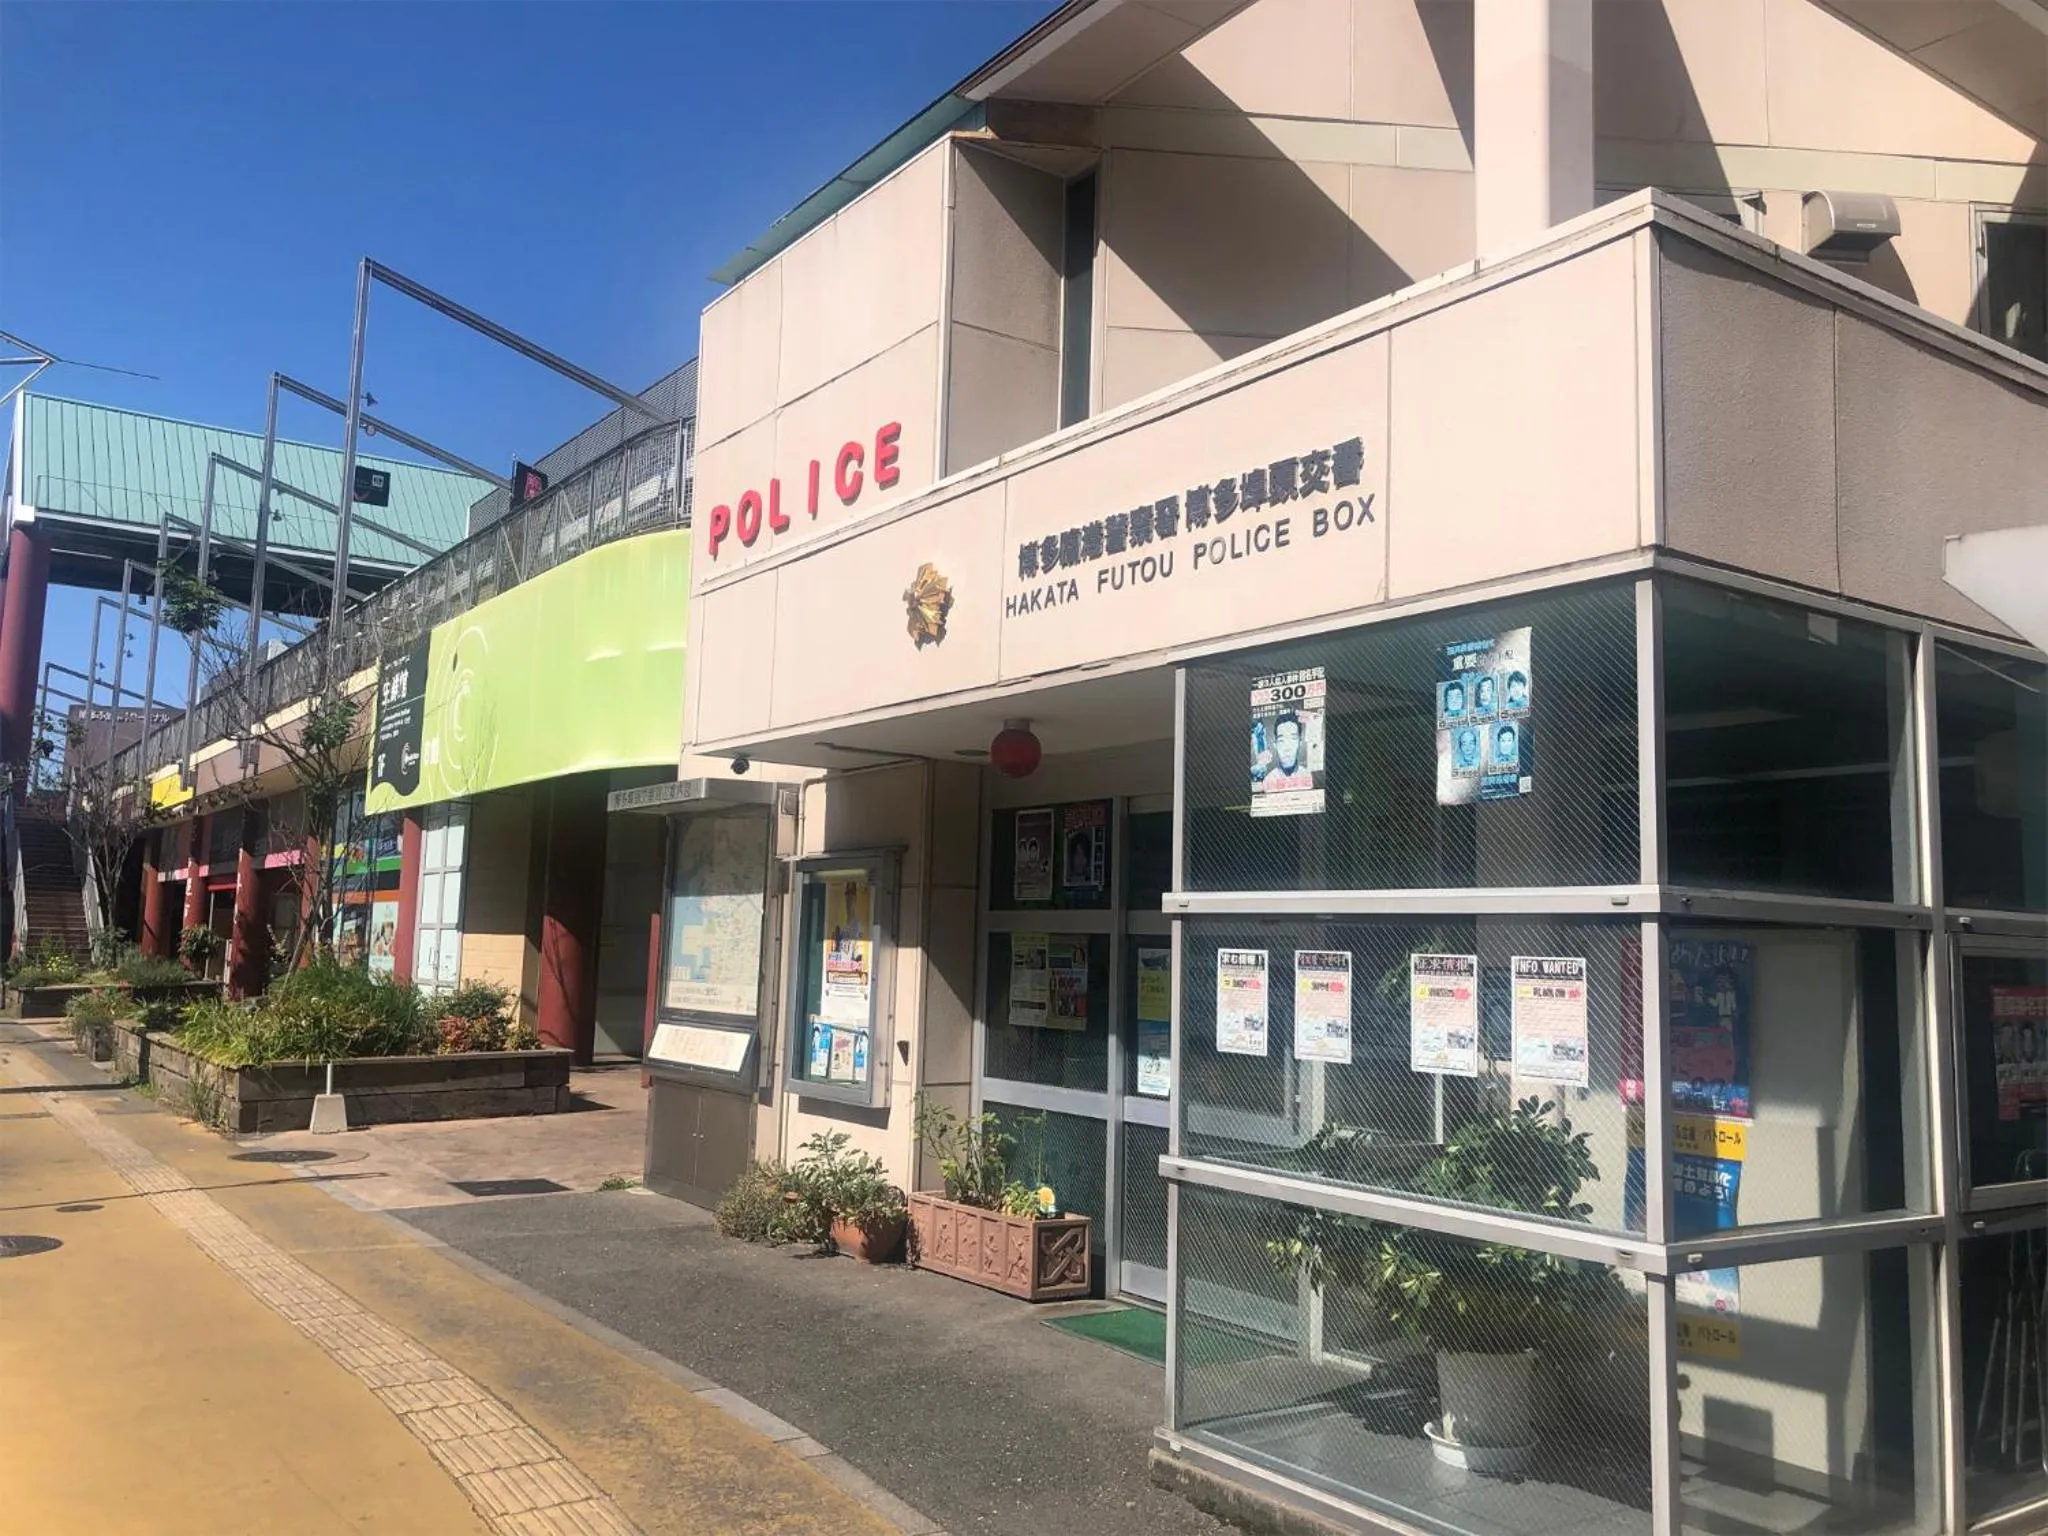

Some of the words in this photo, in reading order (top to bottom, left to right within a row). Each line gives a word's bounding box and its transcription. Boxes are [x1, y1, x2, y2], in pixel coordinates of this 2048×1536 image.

[708, 421, 902, 561] POLICE
[1006, 579, 1079, 618] HAKATA
[1097, 551, 1174, 594] FUTOU
[1193, 518, 1290, 570] POLICE
[1312, 493, 1376, 538] BOX
[1516, 959, 1538, 973] INFO
[1542, 961, 1578, 975] WANTED
